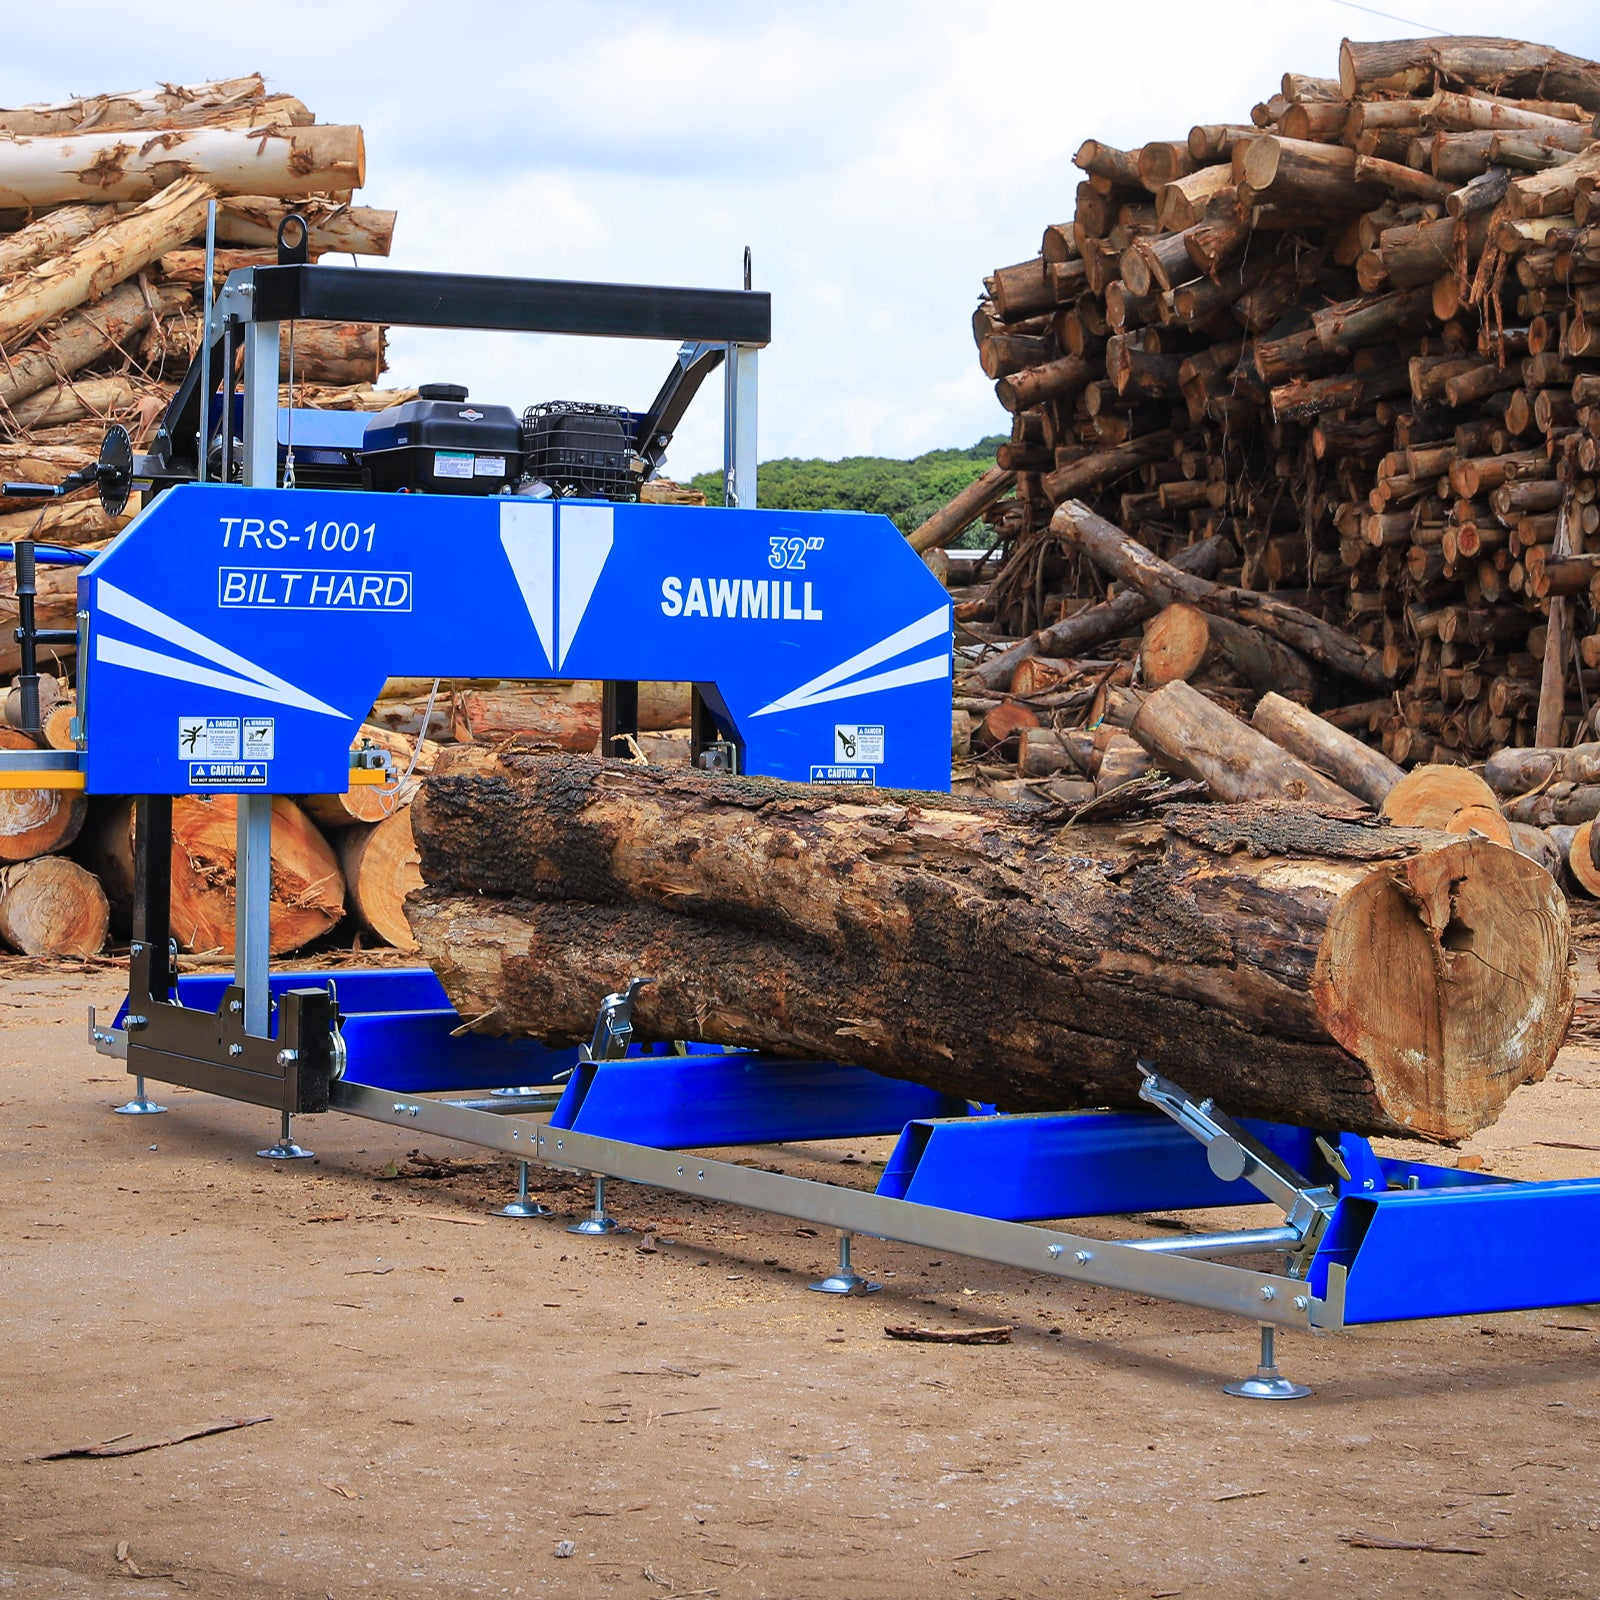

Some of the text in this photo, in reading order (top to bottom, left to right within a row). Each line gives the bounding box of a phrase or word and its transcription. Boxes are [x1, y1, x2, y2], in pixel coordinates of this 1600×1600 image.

[219, 517, 376, 552] TRS-1001
[223, 572, 408, 607] BILT HARD
[660, 576, 823, 621] SAWMILL
[215, 720, 237, 728] DANGER
[210, 765, 246, 776] CAUTION
[827, 768, 857, 779] CAUTION
